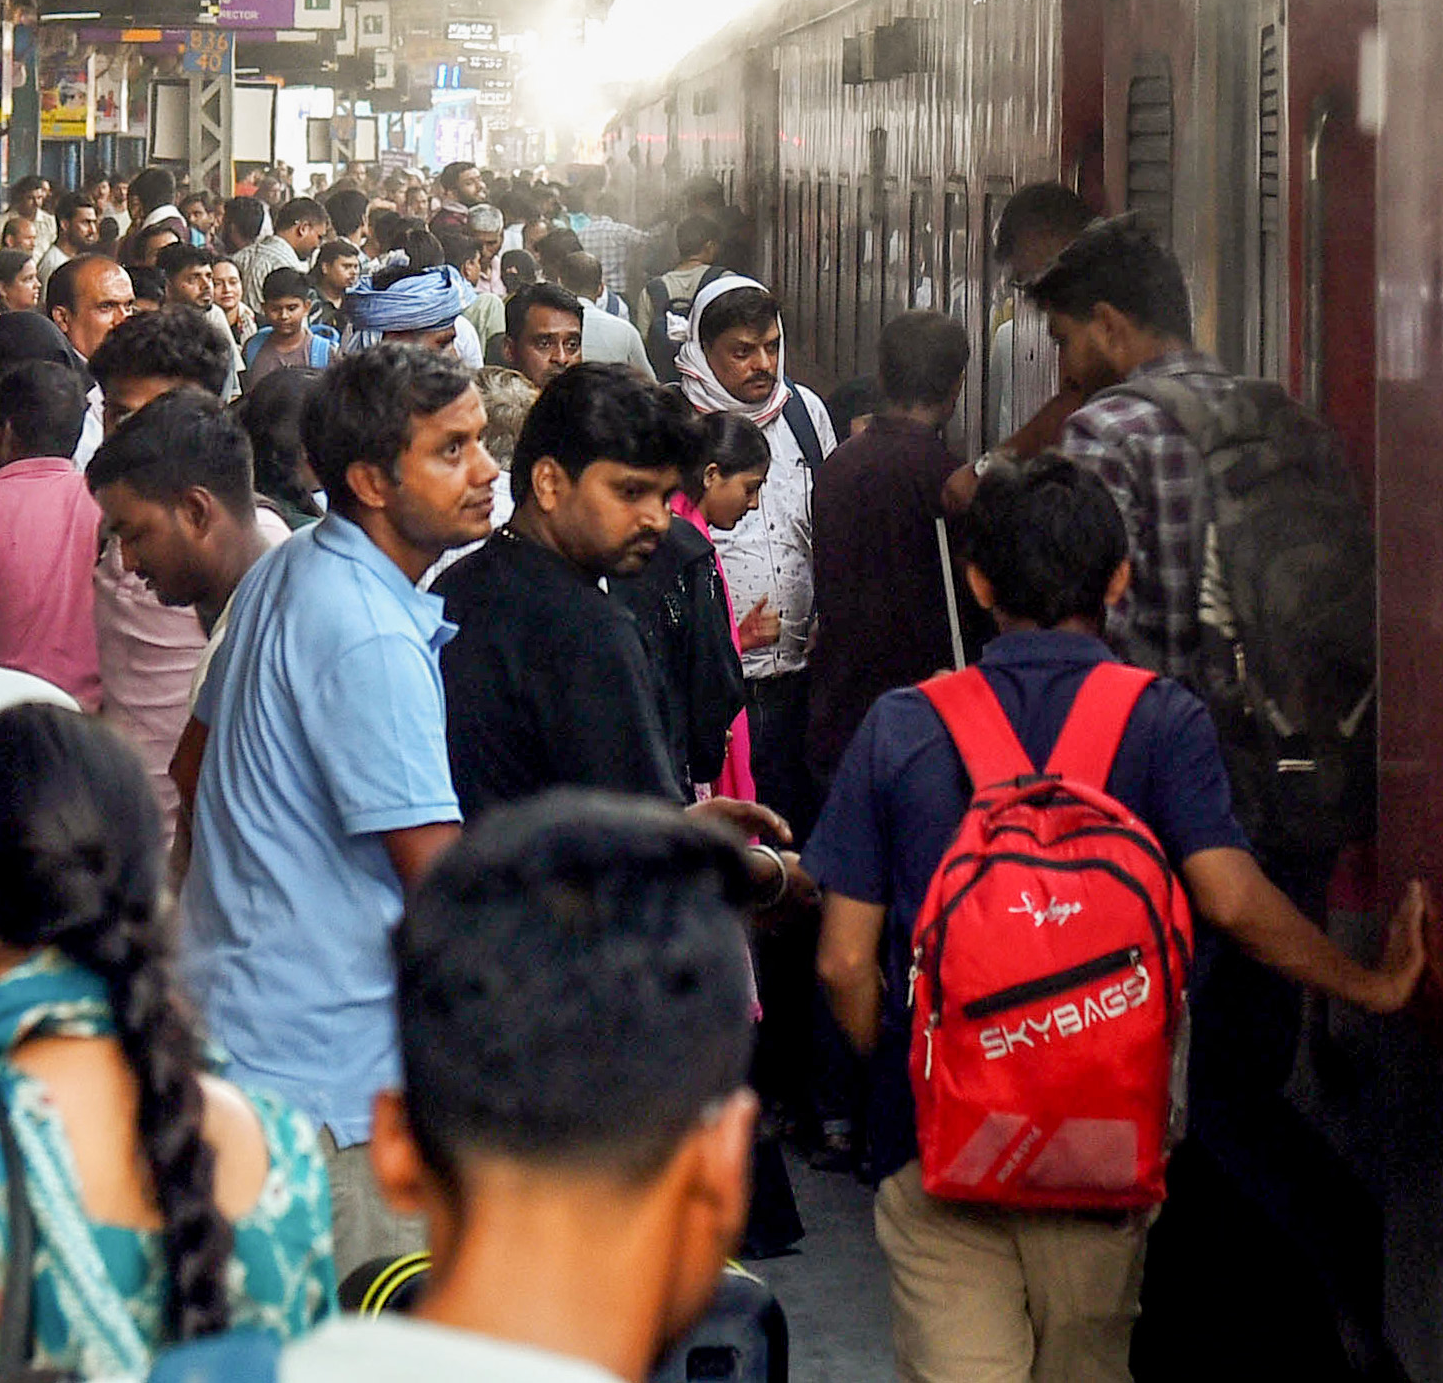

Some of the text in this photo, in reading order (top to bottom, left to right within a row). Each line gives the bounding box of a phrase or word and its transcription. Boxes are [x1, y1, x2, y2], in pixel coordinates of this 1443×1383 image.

[190, 29, 228, 51] 836
[194, 52, 222, 72] 40
[979, 974, 1148, 1060] SKYBAGS
